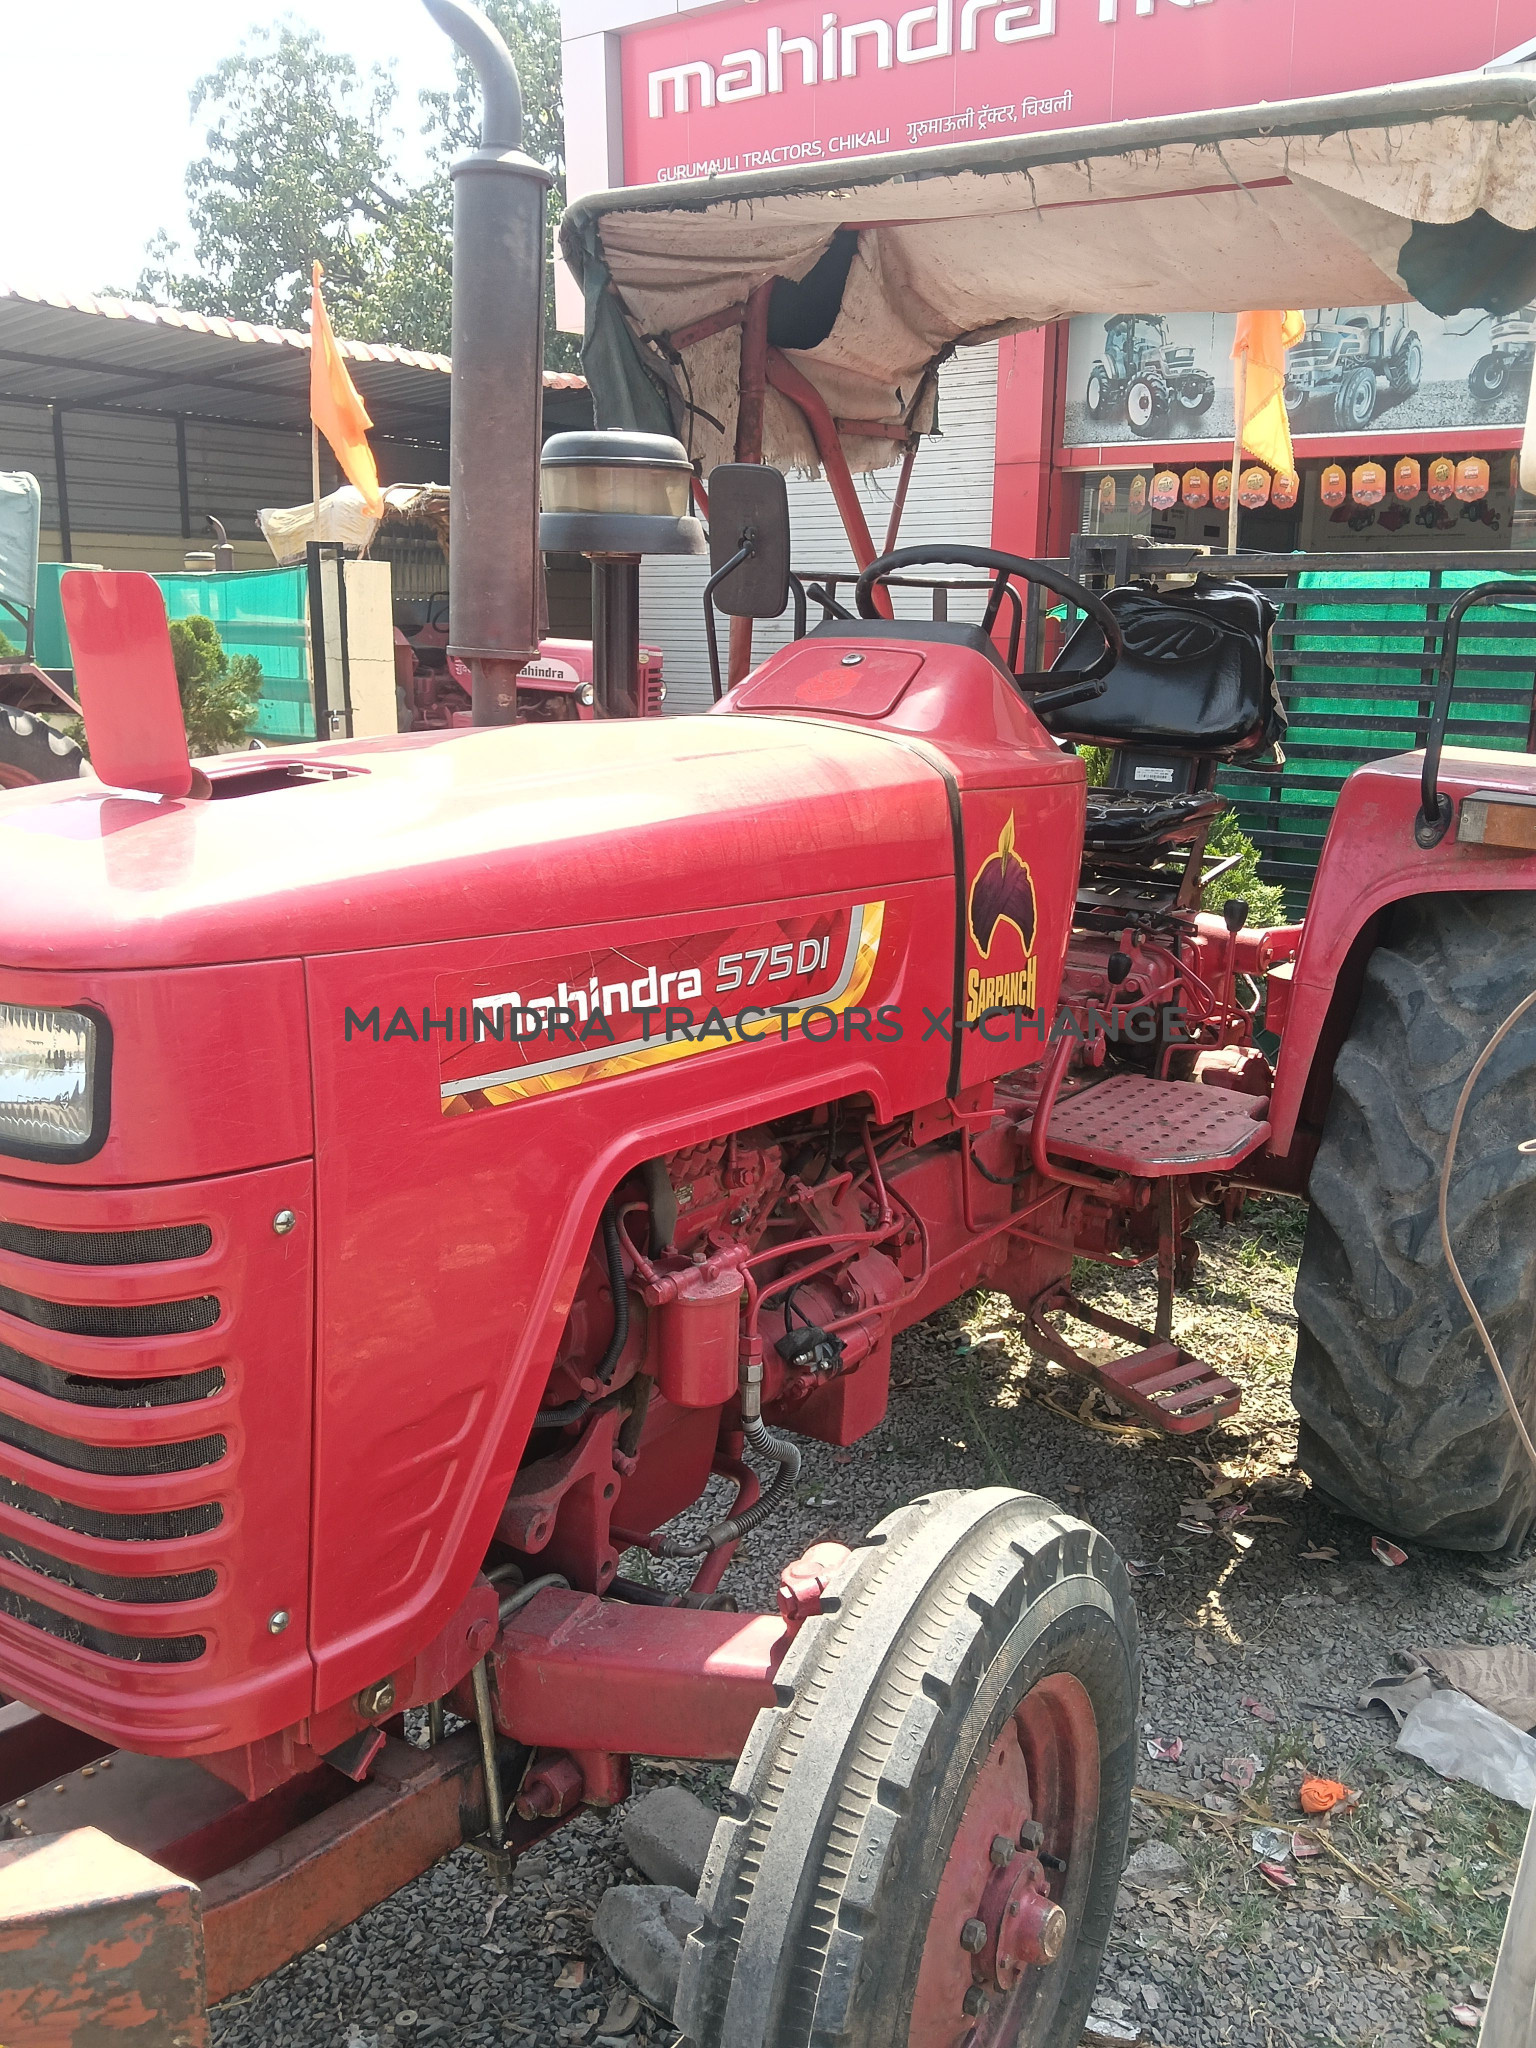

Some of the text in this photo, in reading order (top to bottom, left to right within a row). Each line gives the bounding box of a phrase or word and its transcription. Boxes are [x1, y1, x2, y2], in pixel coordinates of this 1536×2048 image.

[648, 0, 1055, 120] mahindra
[906, 106, 976, 145] गुरुमाऊली
[1021, 89, 1074, 119] चिखली
[656, 127, 890, 183] GURUMAULI TRACTORS, CHIKALI
